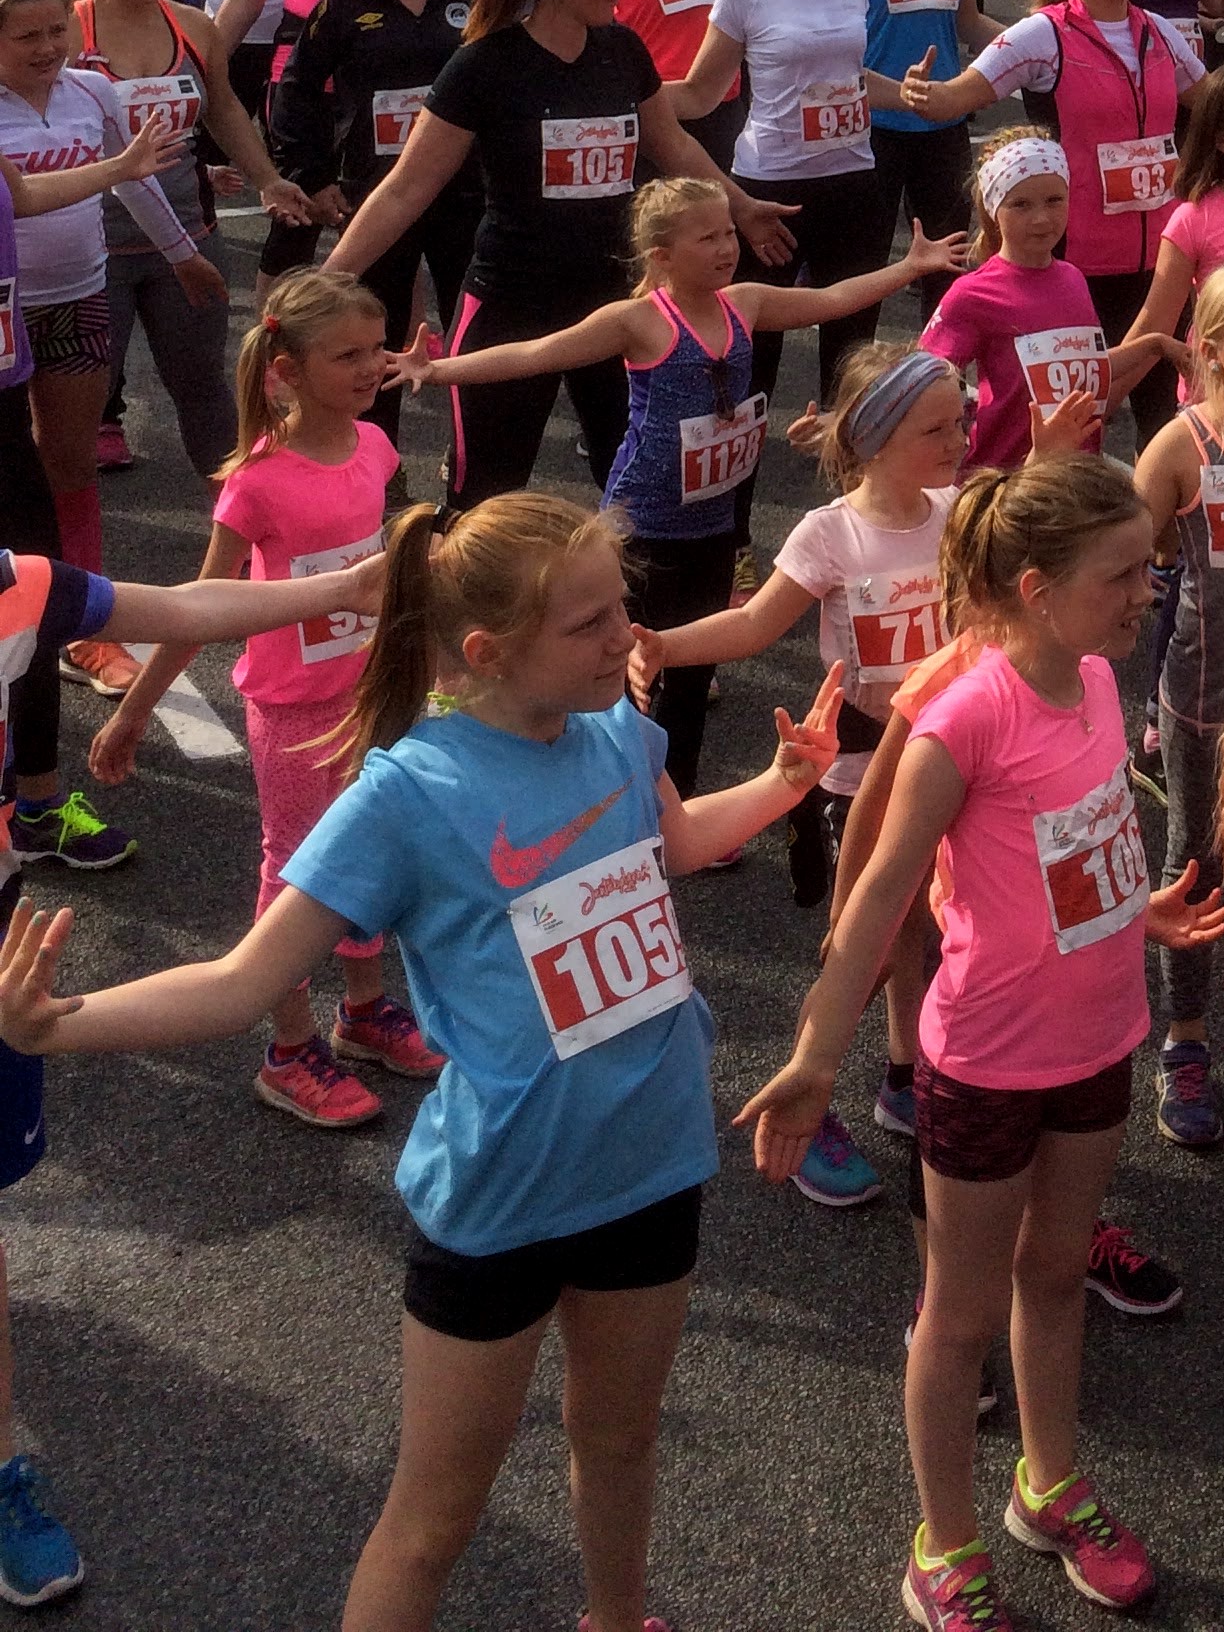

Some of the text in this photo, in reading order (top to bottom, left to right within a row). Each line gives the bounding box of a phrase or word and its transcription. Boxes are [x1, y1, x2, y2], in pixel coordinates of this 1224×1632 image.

[818, 103, 865, 140] 933
[567, 146, 625, 184] 105
[1131, 162, 1166, 200] 93
[1048, 359, 1100, 402] 926
[696, 427, 761, 488] 1128
